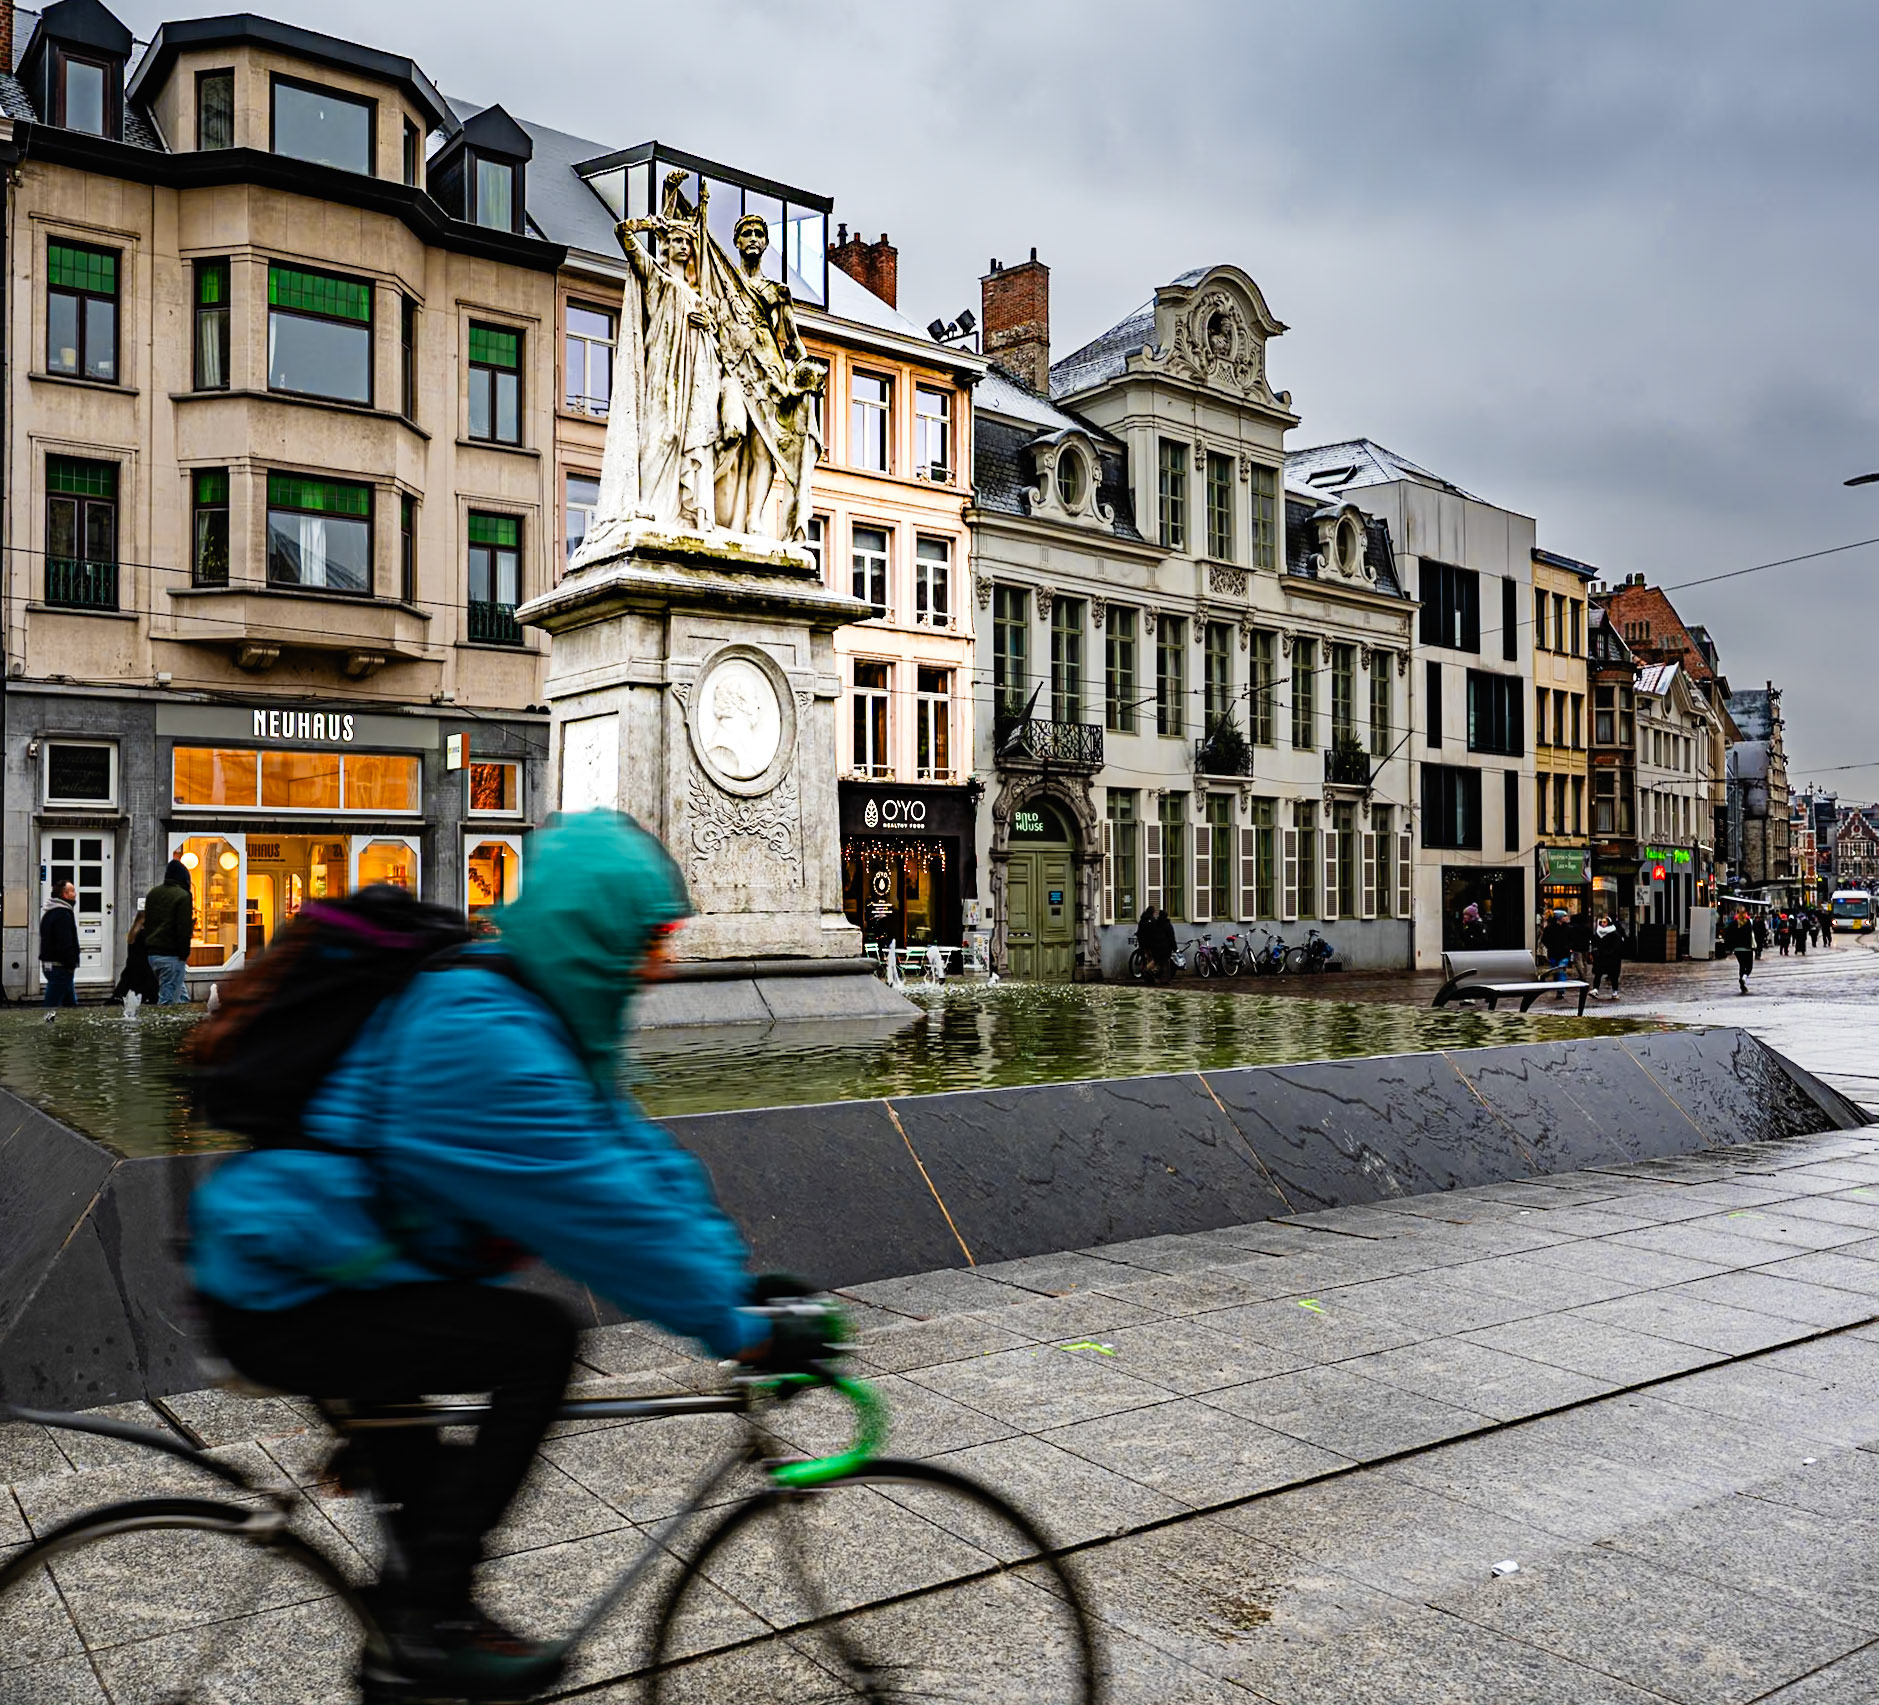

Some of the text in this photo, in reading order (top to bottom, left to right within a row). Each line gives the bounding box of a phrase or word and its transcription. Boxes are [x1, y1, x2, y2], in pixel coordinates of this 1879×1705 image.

[253, 709, 354, 742] NEUHAUS
[882, 799, 926, 821] O'YO
[1015, 811, 1039, 822] BOLD
[1016, 822, 1044, 832] HOUSE
[247, 843, 281, 857] UHAUS
